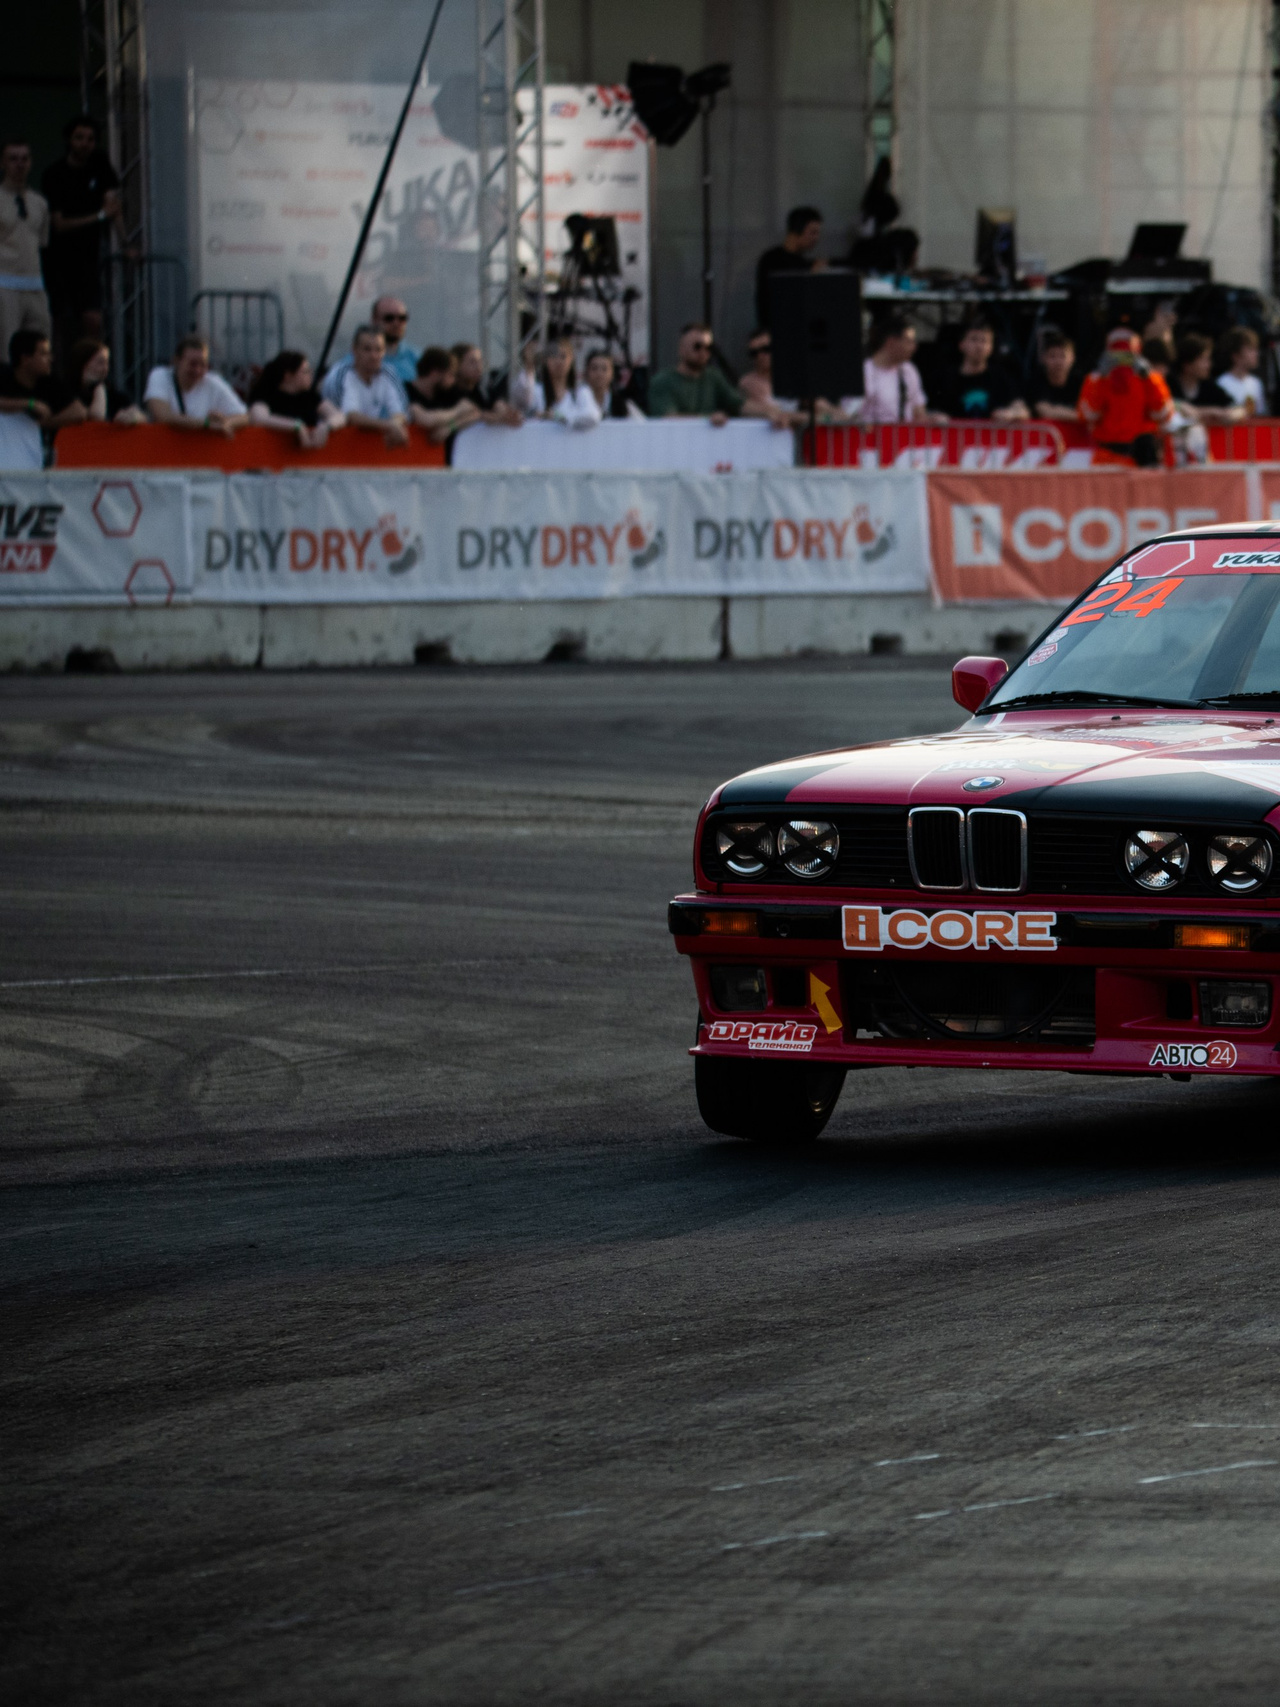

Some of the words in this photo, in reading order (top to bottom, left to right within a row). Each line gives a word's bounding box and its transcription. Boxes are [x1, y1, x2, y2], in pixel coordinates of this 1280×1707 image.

[0, 505, 63, 538] VE
[694, 519, 850, 561] DRYDRY
[204, 528, 372, 572] DRYDRY
[457, 525, 624, 570] DRYDRY
[1060, 577, 1186, 628] 24
[844, 908, 1055, 948] iCORE
